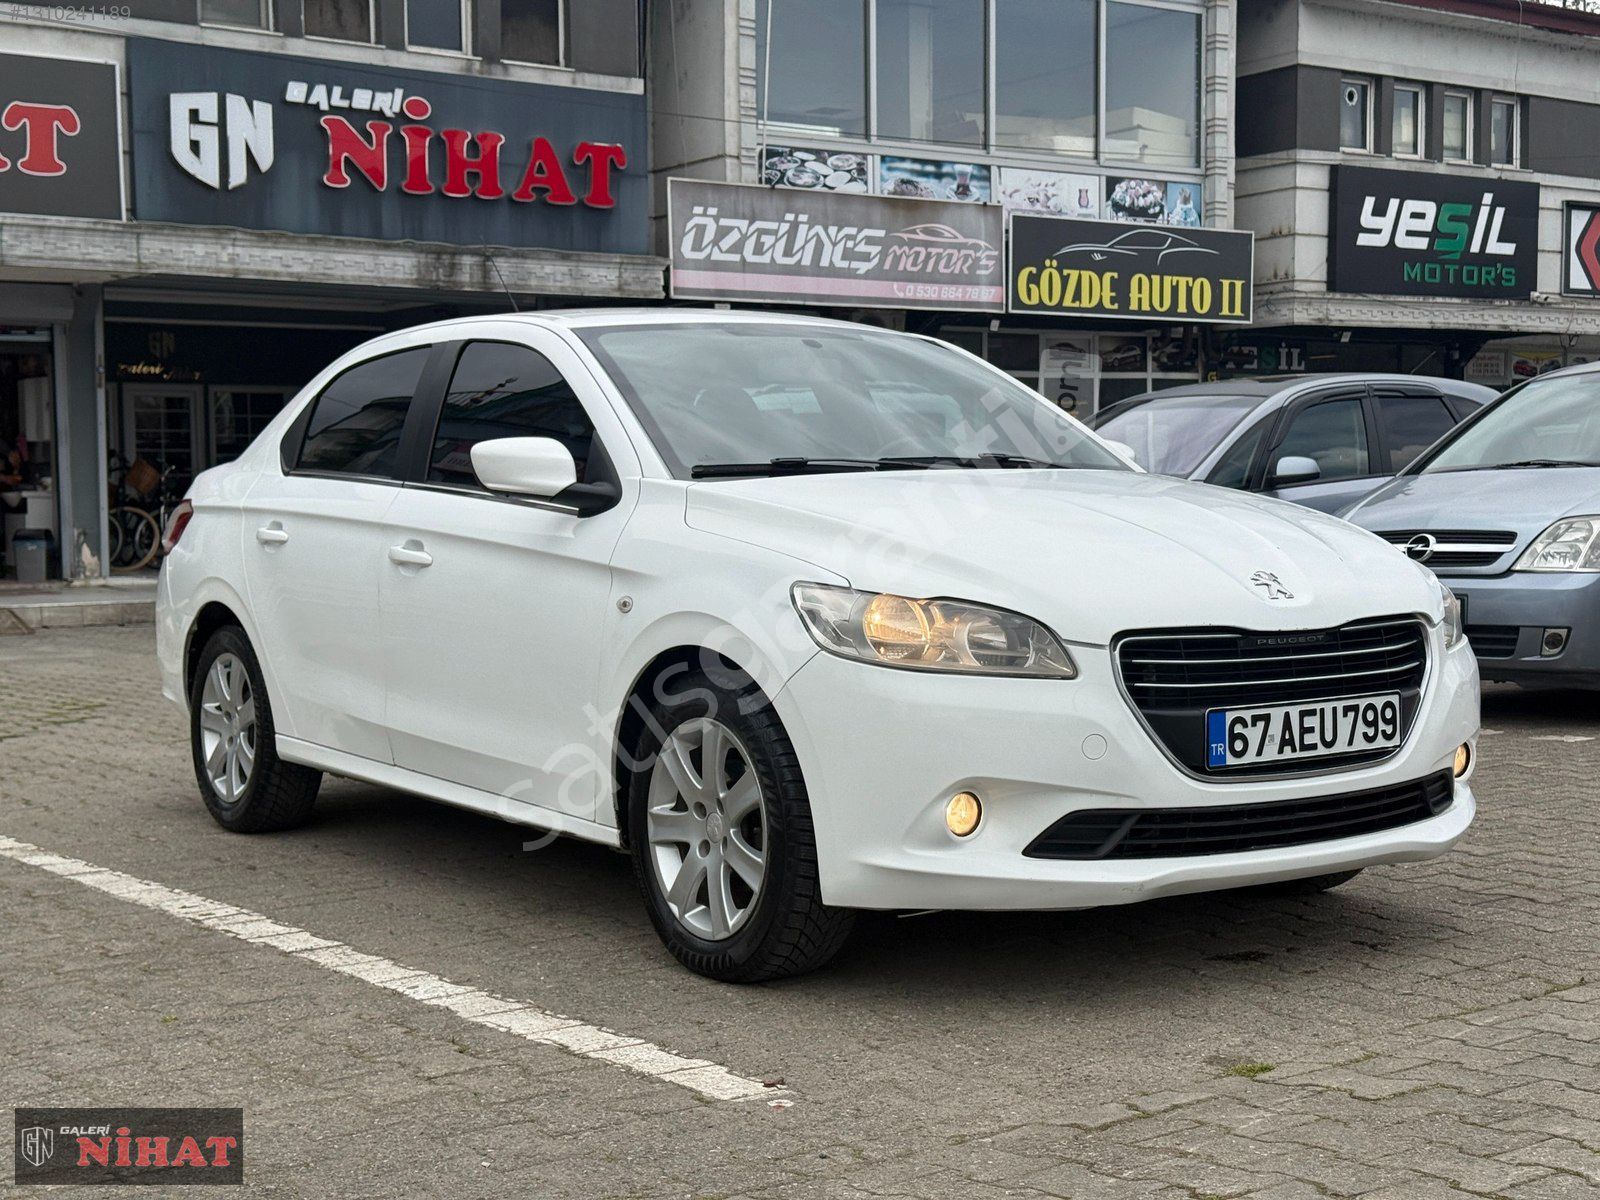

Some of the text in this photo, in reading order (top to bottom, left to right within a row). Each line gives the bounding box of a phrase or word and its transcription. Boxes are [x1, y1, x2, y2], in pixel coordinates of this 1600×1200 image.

[0, 100, 81, 176] T
[169, 92, 274, 190] GN
[320, 95, 628, 209] NİHAT
[680, 206, 998, 275] ÖZGÜNEŞ MOTOR'S
[1017, 258, 1246, 317] GÖZDE AUTO II
[1403, 261, 1516, 287] MOTOR'S
[1257, 634, 1325, 646] PEUGEOT
[1211, 743, 1225, 756] TR
